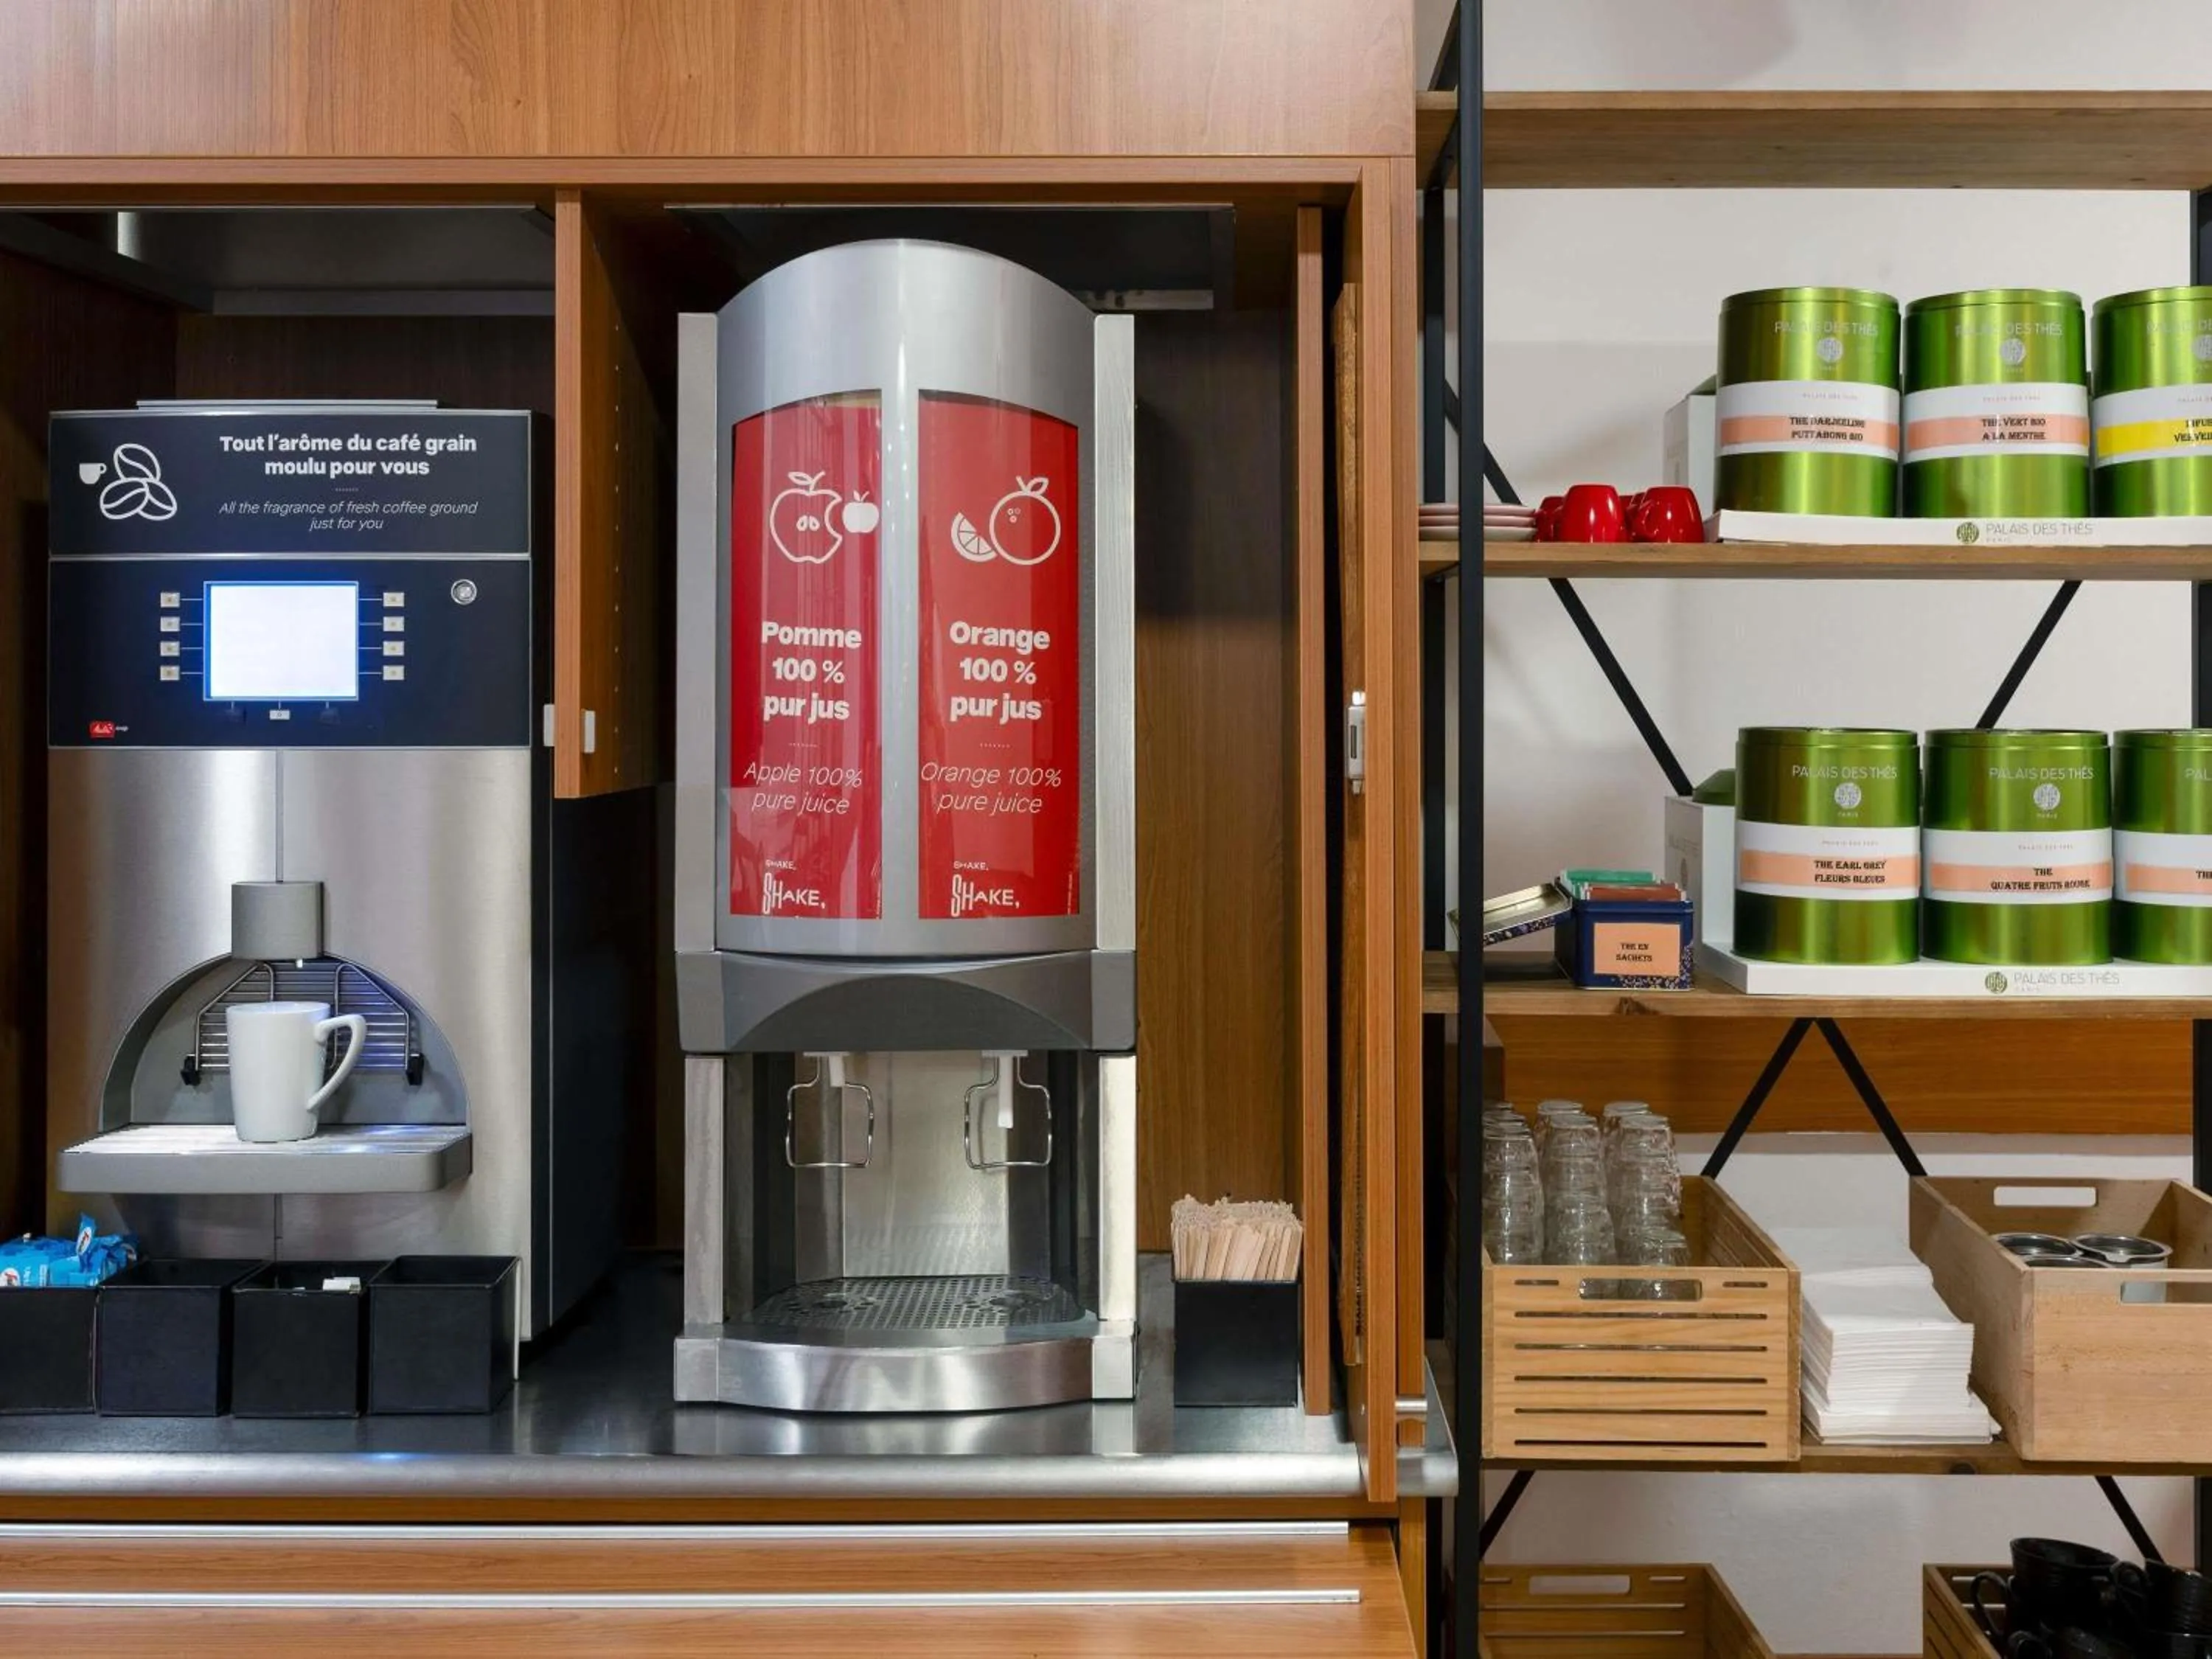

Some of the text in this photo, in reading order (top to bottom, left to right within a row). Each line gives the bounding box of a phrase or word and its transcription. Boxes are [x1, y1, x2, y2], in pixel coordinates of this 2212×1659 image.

[2003, 417, 2028, 426] VERT
[2030, 417, 2046, 426] BIO
[220, 436, 265, 452] Tout
[347, 434, 372, 451] du
[375, 434, 421, 452] café
[424, 434, 478, 456] grain
[2008, 431, 2046, 440] MENTHE
[264, 457, 431, 479] moulu pour vous
[219, 501, 479, 517] All the fragrance of fresh coffee ground
[307, 517, 384, 532] just for you
[1986, 523, 2028, 535] PALAIS
[2033, 522, 2058, 535] DES
[760, 620, 862, 650] Pomme
[949, 621, 1051, 655] Orange
[771, 658, 846, 685] 100 %
[959, 658, 1037, 686] 100 %
[762, 692, 850, 725] pur jus
[949, 692, 1043, 725] pur jus
[742, 761, 863, 788] Apple 100%
[920, 762, 1062, 788] Orange 100%
[1792, 765, 1839, 779] PALAIS
[1841, 766, 1868, 779] DES
[1989, 765, 2095, 779] PALAIS DES THÉS
[751, 792, 850, 817] pure juice
[935, 792, 1043, 817] pure juice
[1835, 860, 1862, 869] EARL
[1863, 860, 1887, 869] GREY
[1814, 874, 1886, 884] FLEURS BLEUES
[1990, 880, 2032, 890] QUATRE
[2033, 881, 2064, 890] FRUITS
[1615, 953, 1652, 962] SACHETS
[2013, 971, 2121, 985] PALAIS DES THÉS
